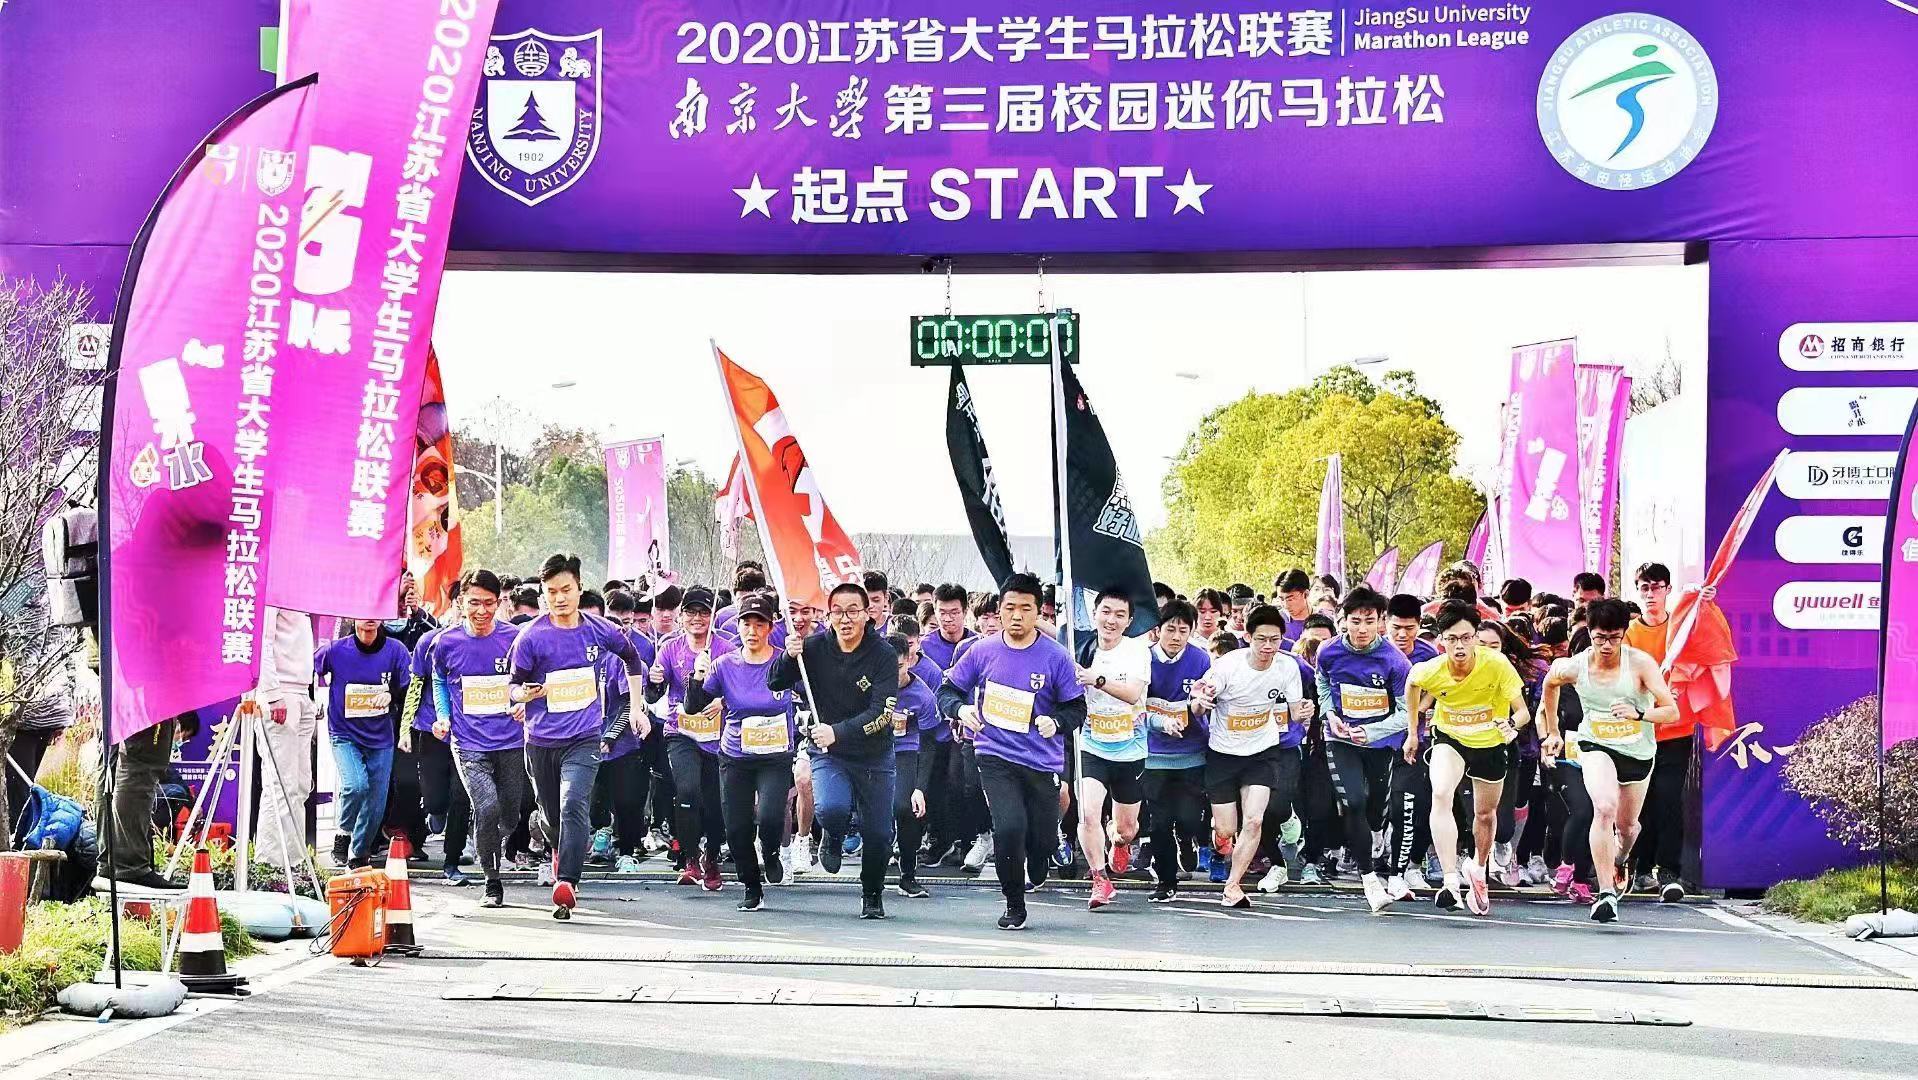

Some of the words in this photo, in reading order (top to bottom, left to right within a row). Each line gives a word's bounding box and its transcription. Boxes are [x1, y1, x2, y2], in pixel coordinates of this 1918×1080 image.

[1354, 8, 1429, 29] JiangSu
[1434, 3, 1531, 24] University
[676, 8, 1334, 65] 2020江苏省大学生马拉松联赛
[1354, 30, 1451, 50] Marathon
[1456, 29, 1530, 50] League
[884, 73, 1445, 134] 第三届校园迷你马拉松
[470, 107, 513, 181] NANJING
[525, 109, 593, 193] UNIVERSITY
[518, 152, 545, 162] 1902
[791, 165, 909, 225] 起点
[929, 166, 1164, 222] START
[1831, 336, 1905, 352] 招商银行
[221, 203, 290, 664] 2020江苏省大学生马拉松联赛
[1793, 594, 1864, 613] yuwell
[1093, 718, 1128, 731] F0004
